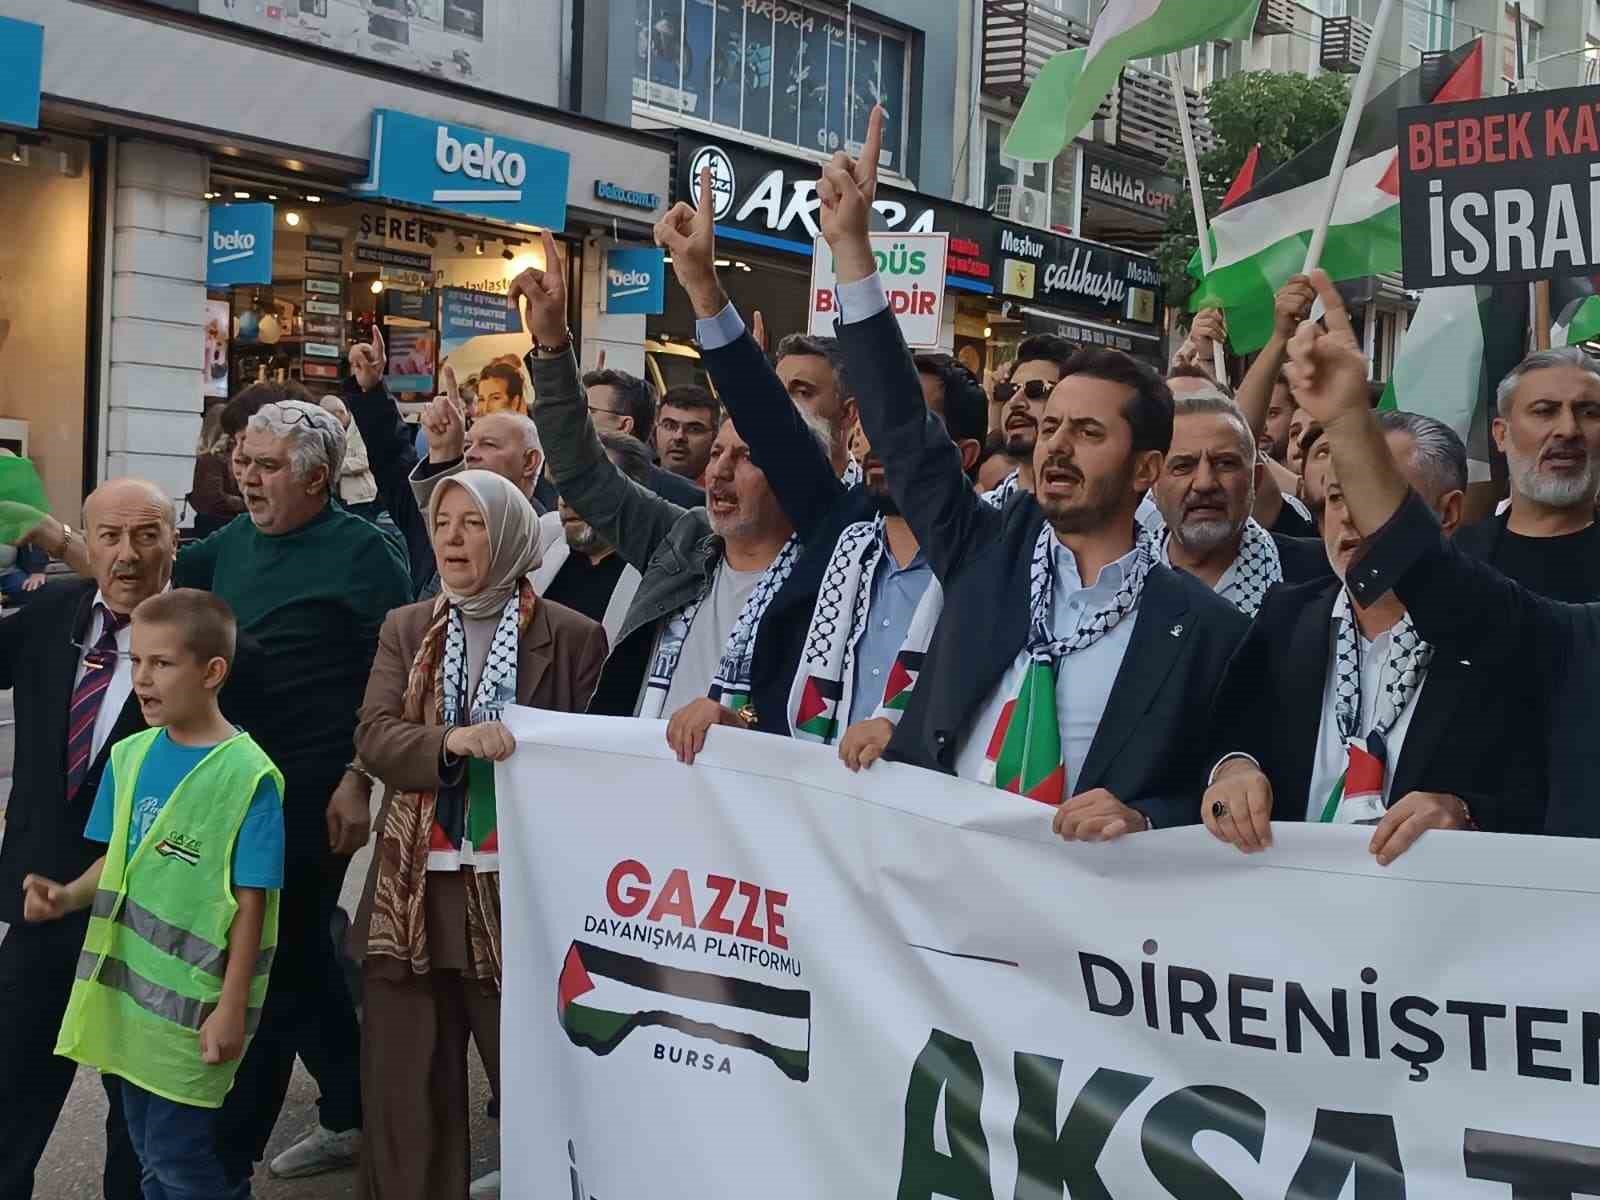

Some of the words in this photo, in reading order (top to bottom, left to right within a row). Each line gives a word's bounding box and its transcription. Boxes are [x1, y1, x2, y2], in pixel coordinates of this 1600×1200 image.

[737, 0, 814, 33] ARORA
[435, 125, 527, 187] beko
[1408, 111, 1534, 171] BEBEK
[1545, 103, 1600, 157] KA
[1090, 164, 1145, 204] BAHAR
[213, 230, 255, 250] beko
[1001, 229, 1043, 259] Meşhur
[610, 269, 651, 286] beko
[1044, 248, 1125, 305] çalıkuşu
[605, 858, 789, 951] GAZZE
[583, 914, 697, 952] DAYANIŞMA
[704, 936, 802, 977] PLATFORMU
[1077, 938, 1600, 1086] DİRENİŞTE
[653, 1043, 733, 1075] BURSA
